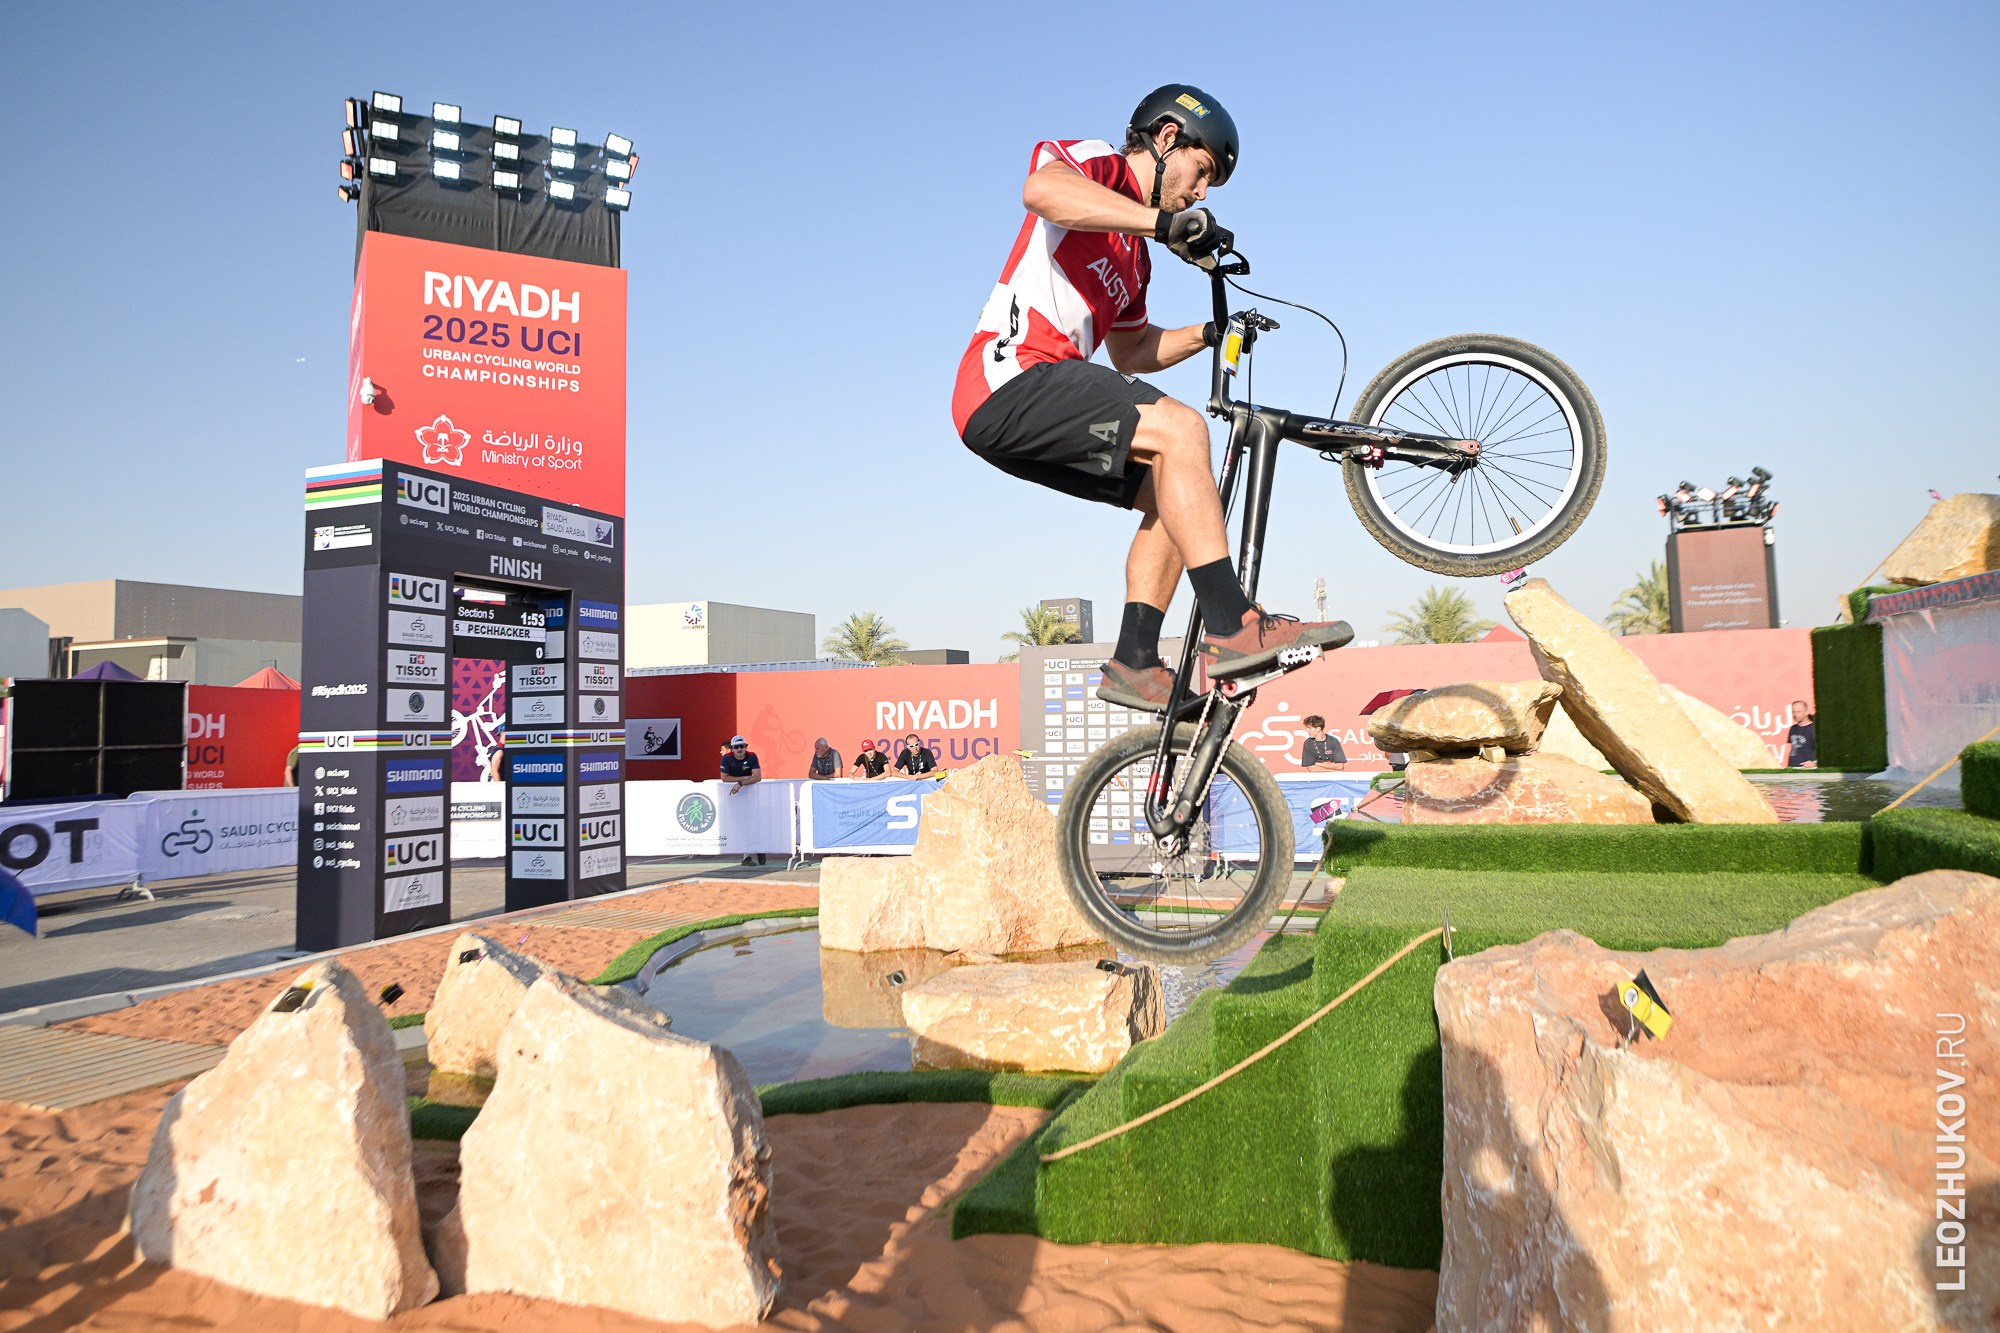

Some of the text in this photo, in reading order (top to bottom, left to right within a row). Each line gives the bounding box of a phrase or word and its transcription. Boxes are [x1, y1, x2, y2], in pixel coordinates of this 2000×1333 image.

[424, 270, 580, 323] RIYADH
[423, 315, 580, 357] 2025 UCI
[423, 348, 581, 375] URBAN CYCLING WORLD
[422, 364, 580, 393] CHAMPIONSHIPS
[482, 429, 582, 456] وزارة الرياضة
[482, 449, 582, 471] Ministry of Sport
[407, 480, 445, 507] UCI
[453, 491, 526, 514] 2025 URBAN CYCLING
[453, 502, 539, 528] WORLD CHAMPIONSHIPS
[546, 512, 567, 523] RIYADH
[546, 522, 585, 538] SAUDI ARABIA
[490, 555, 541, 580] FINISH
[401, 579, 439, 603] UCI
[458, 607, 494, 619] Section 5
[520, 612, 545, 626] 1:53
[580, 608, 617, 620] SHIMANO
[468, 624, 530, 638] PECHHACKER
[396, 665, 437, 677] TISSOT
[1048, 661, 1067, 669] UCI
[519, 676, 557, 686] TISSOT
[585, 676, 614, 685] TISSOT
[311, 684, 367, 698] #Riyadh2025
[876, 698, 997, 730] RIYADH
[327, 736, 349, 747] UCI
[405, 734, 427, 746] UCI
[528, 733, 548, 744] UCI
[592, 732, 607, 742] UCI
[877, 737, 998, 761] 205 UCI
[513, 763, 563, 773] SHIMANO
[580, 761, 618, 772] SHIMANO
[387, 769, 442, 782] SHIMANO
[220, 824, 262, 838] SAUDI
[523, 824, 558, 841] UCI
[589, 820, 615, 839] UCI
[0, 818, 99, 869] OT
[397, 840, 436, 864] UCI
